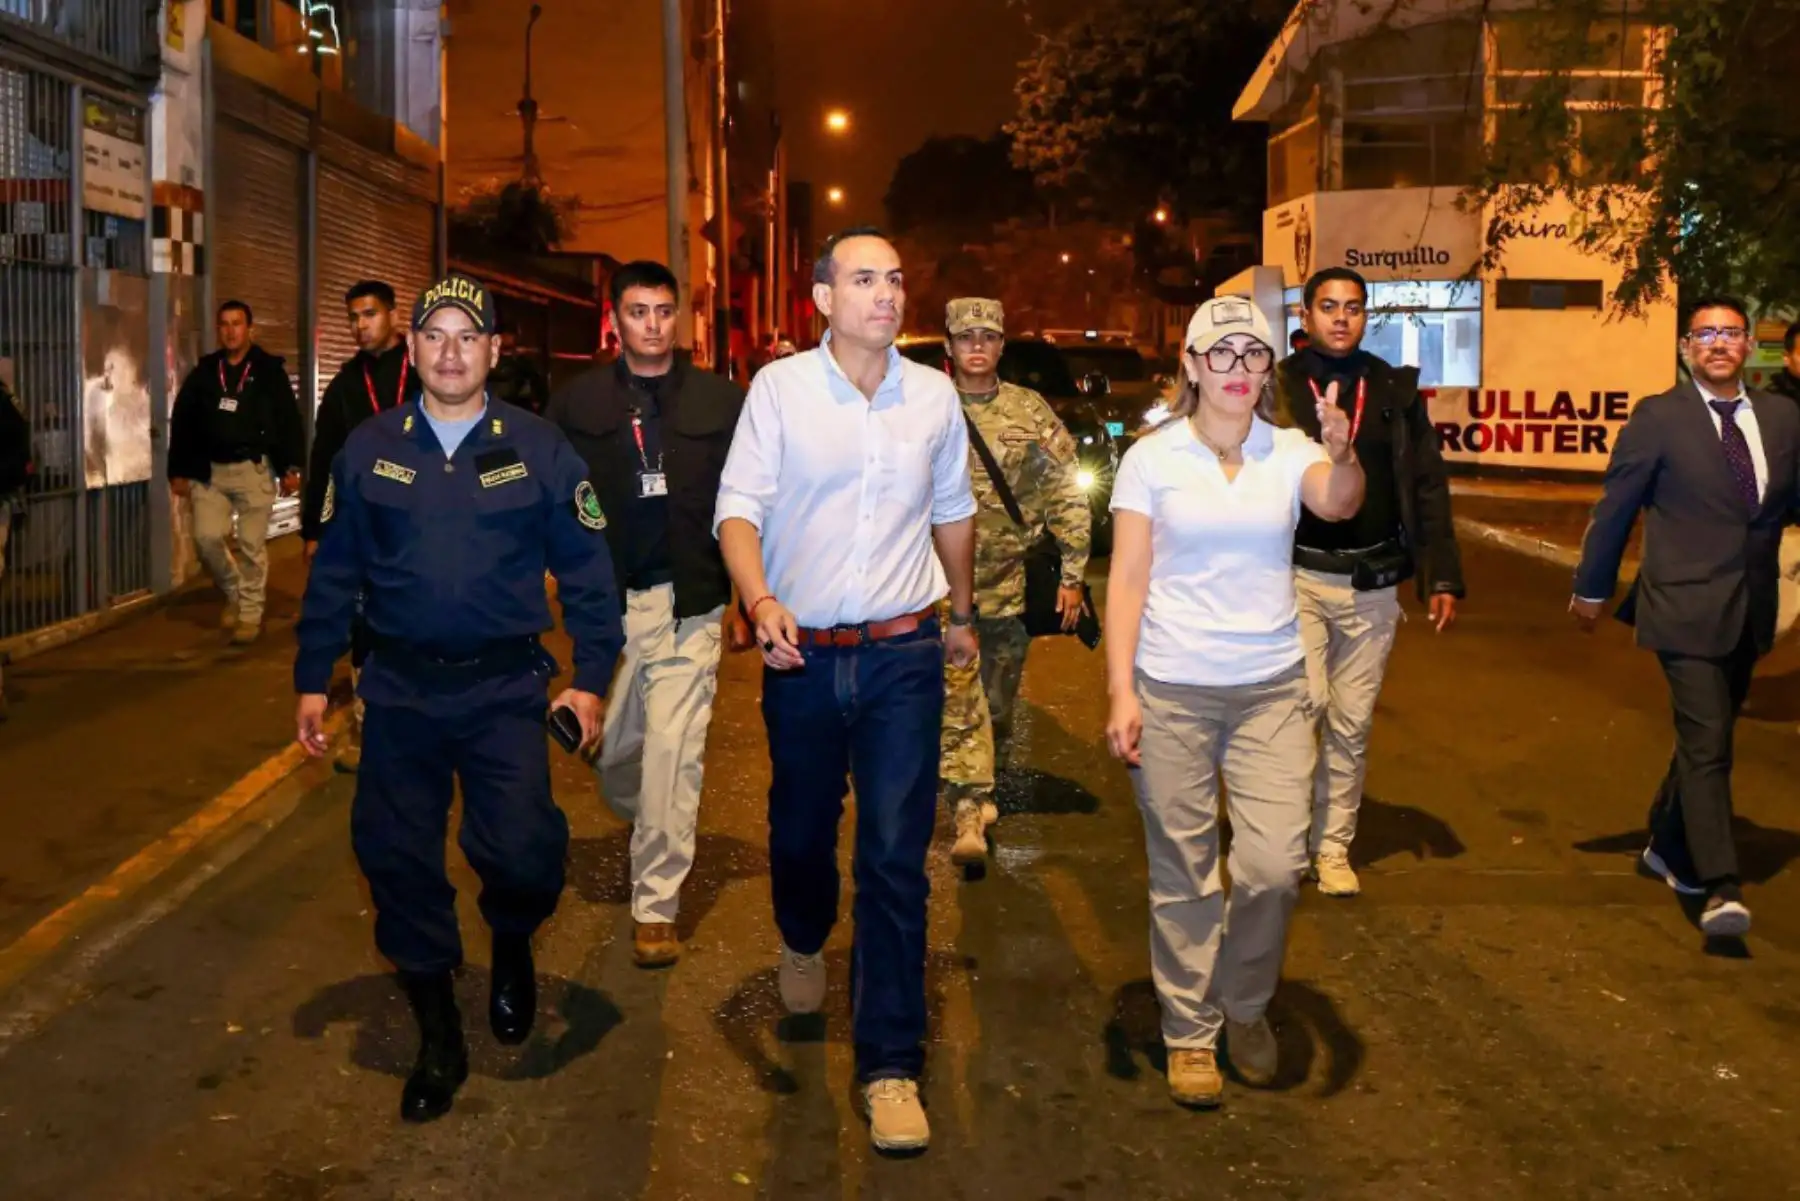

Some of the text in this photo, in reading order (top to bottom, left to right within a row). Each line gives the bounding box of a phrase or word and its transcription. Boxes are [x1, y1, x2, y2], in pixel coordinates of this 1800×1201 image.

[1345, 246, 1450, 271] Surquillo
[423, 277, 484, 311] POLICIA
[1435, 422, 1609, 453] RONTER
